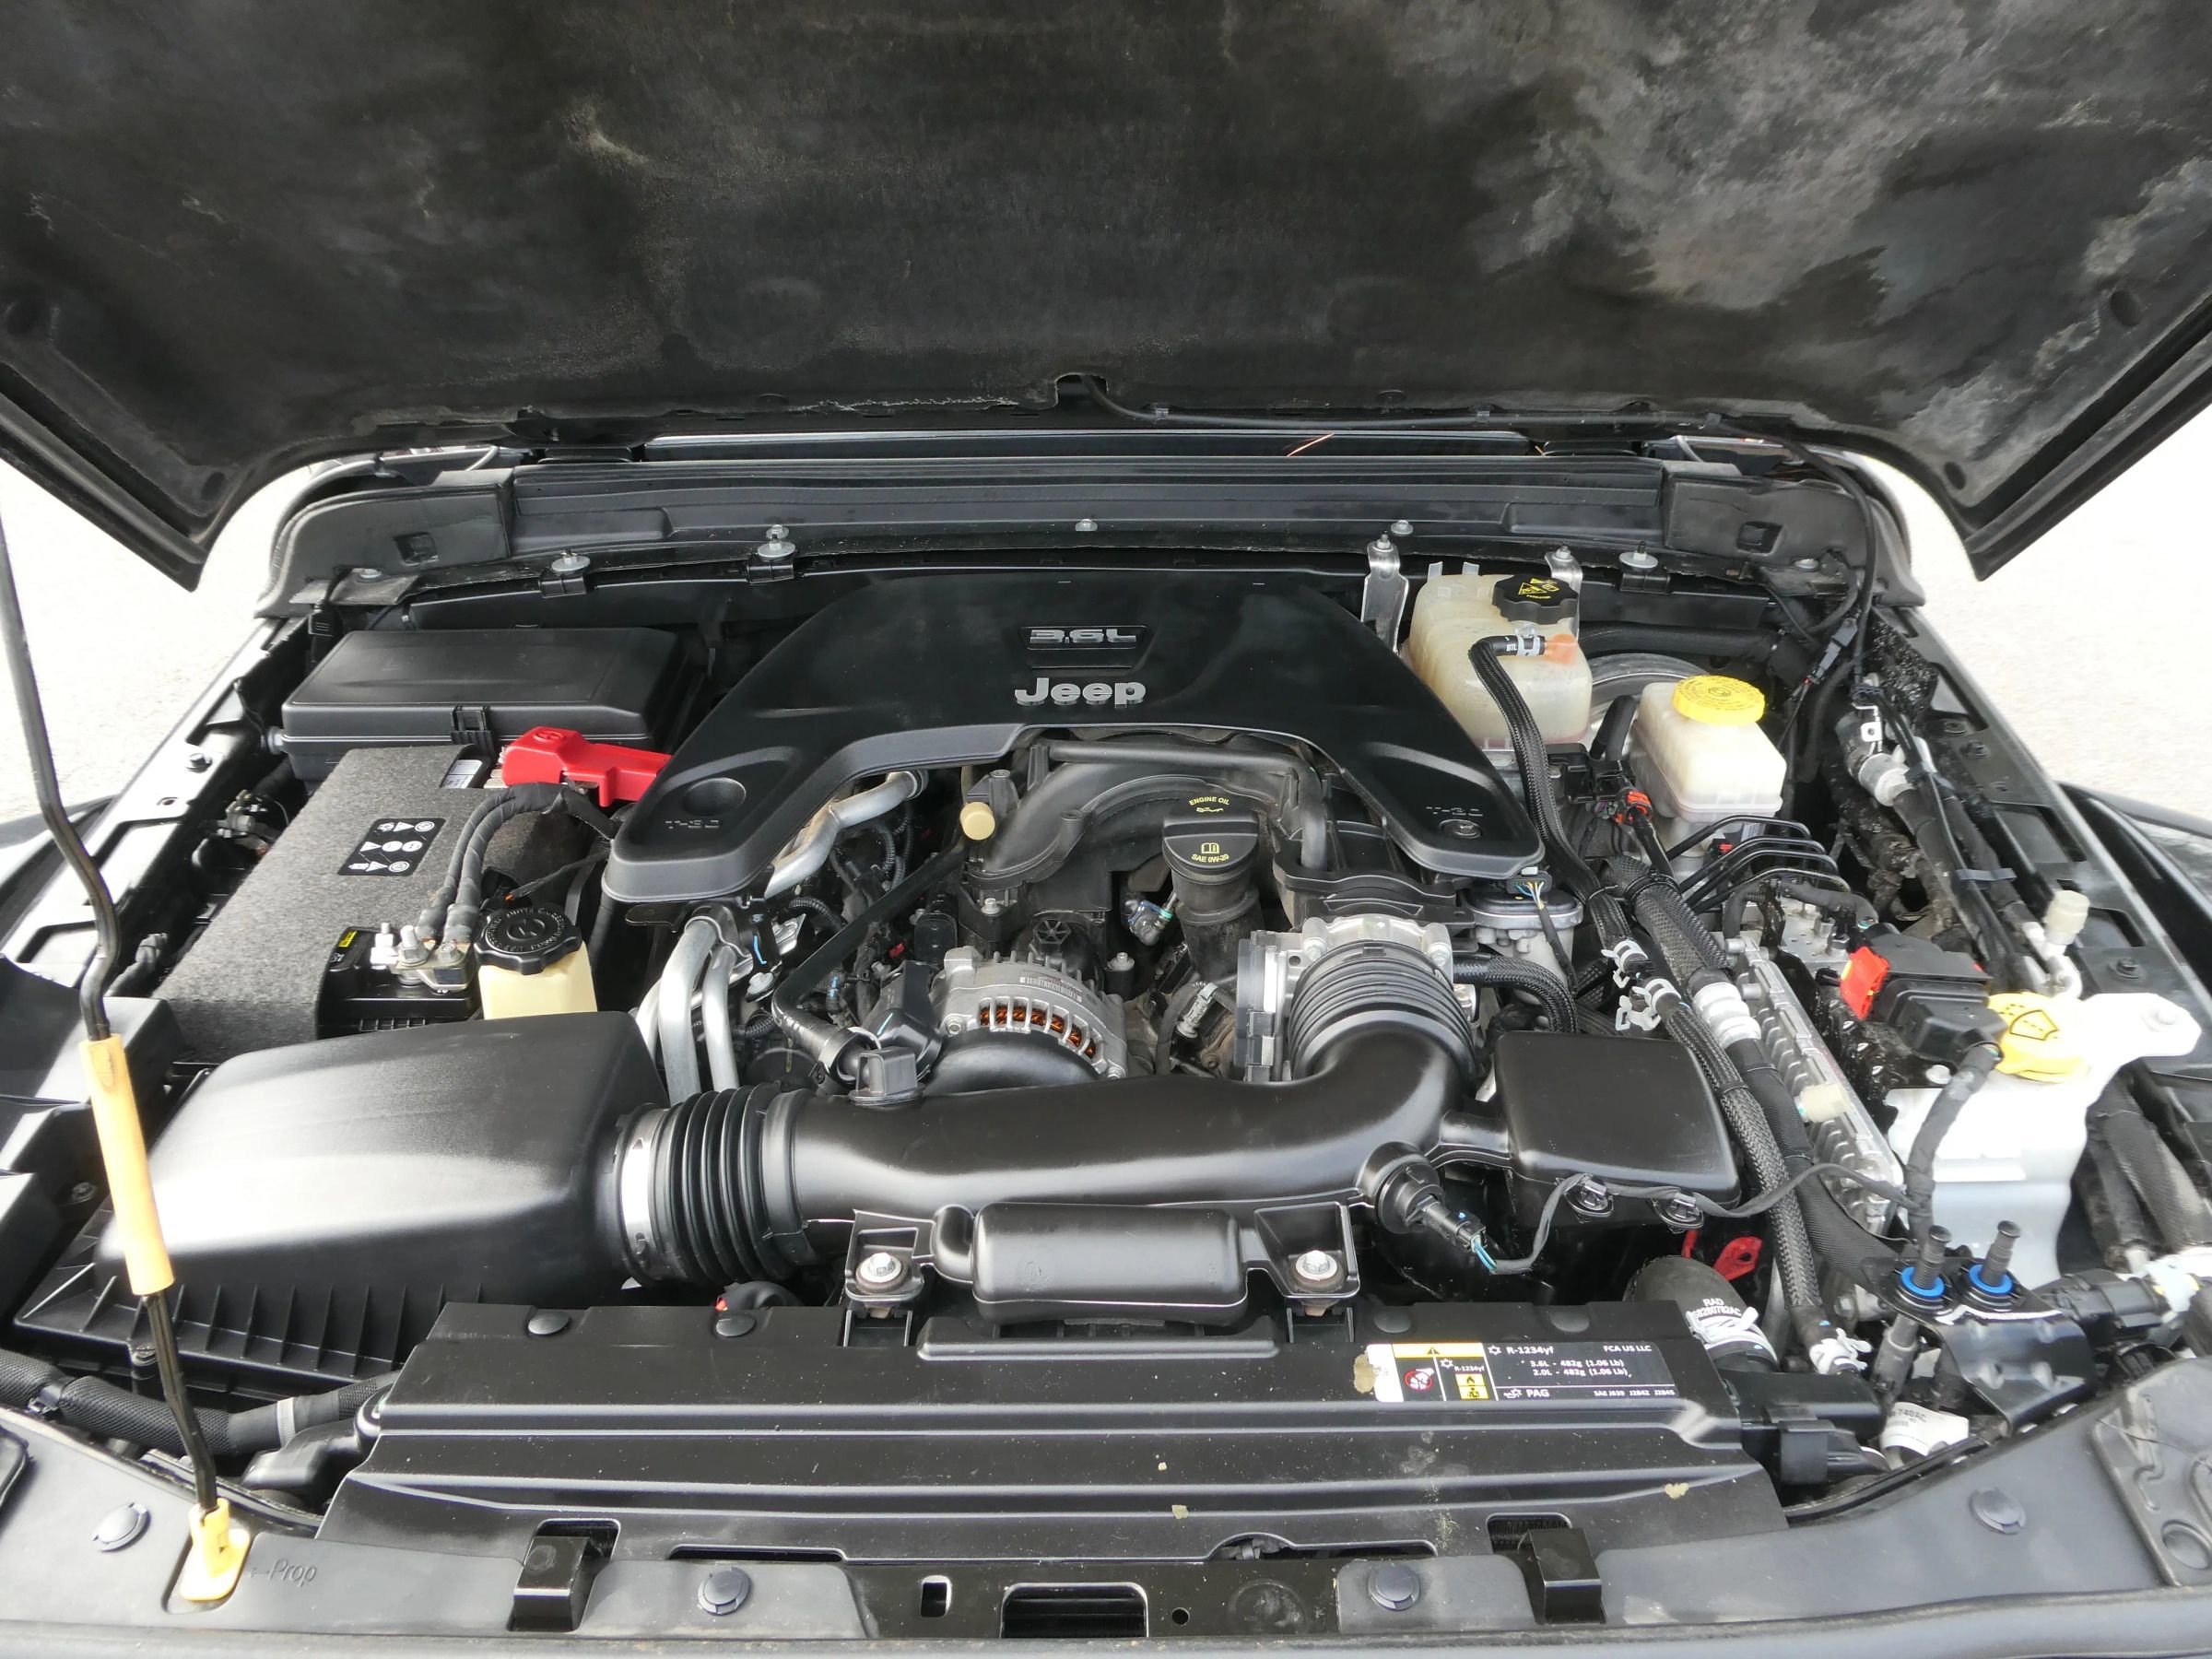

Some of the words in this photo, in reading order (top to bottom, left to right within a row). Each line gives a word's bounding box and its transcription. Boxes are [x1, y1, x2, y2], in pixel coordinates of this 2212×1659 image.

[1030, 629, 1136, 643] 3.6L
[1014, 677, 1147, 707] Jeep
[1188, 795, 1218, 806] ENGINE
[1218, 797, 1230, 806] OIL
[1191, 853, 1206, 863] SAE
[1207, 853, 1230, 863] 0W-20
[1702, 1298, 1724, 1306] RAD
[1505, 1346, 1554, 1356] R-1234yf
[1525, 1389, 1549, 1397] PAG
[267, 1558, 317, 1587] Prop
